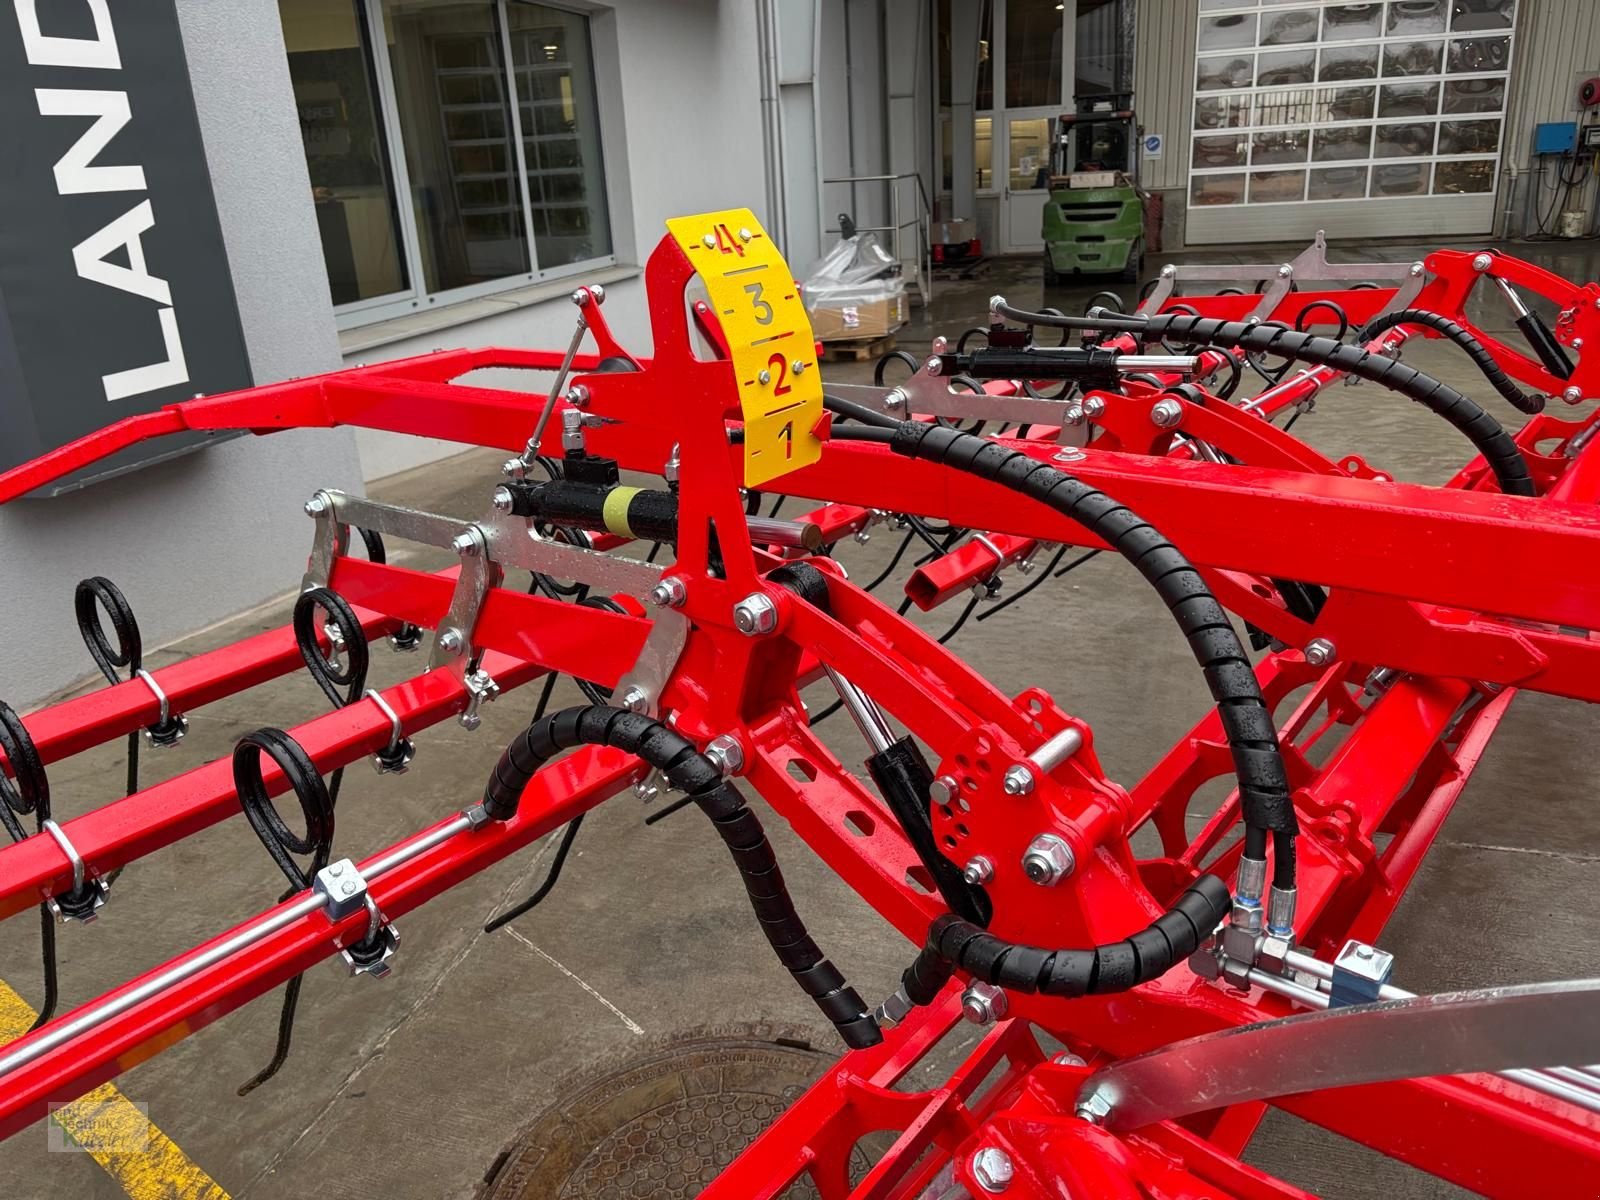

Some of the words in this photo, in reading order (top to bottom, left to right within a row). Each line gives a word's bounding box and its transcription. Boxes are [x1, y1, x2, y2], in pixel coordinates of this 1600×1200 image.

[14, 0, 190, 401] LAND
[713, 223, 745, 258] 4
[743, 282, 774, 326] 3
[767, 352, 792, 397] 2
[777, 419, 794, 460] 1
